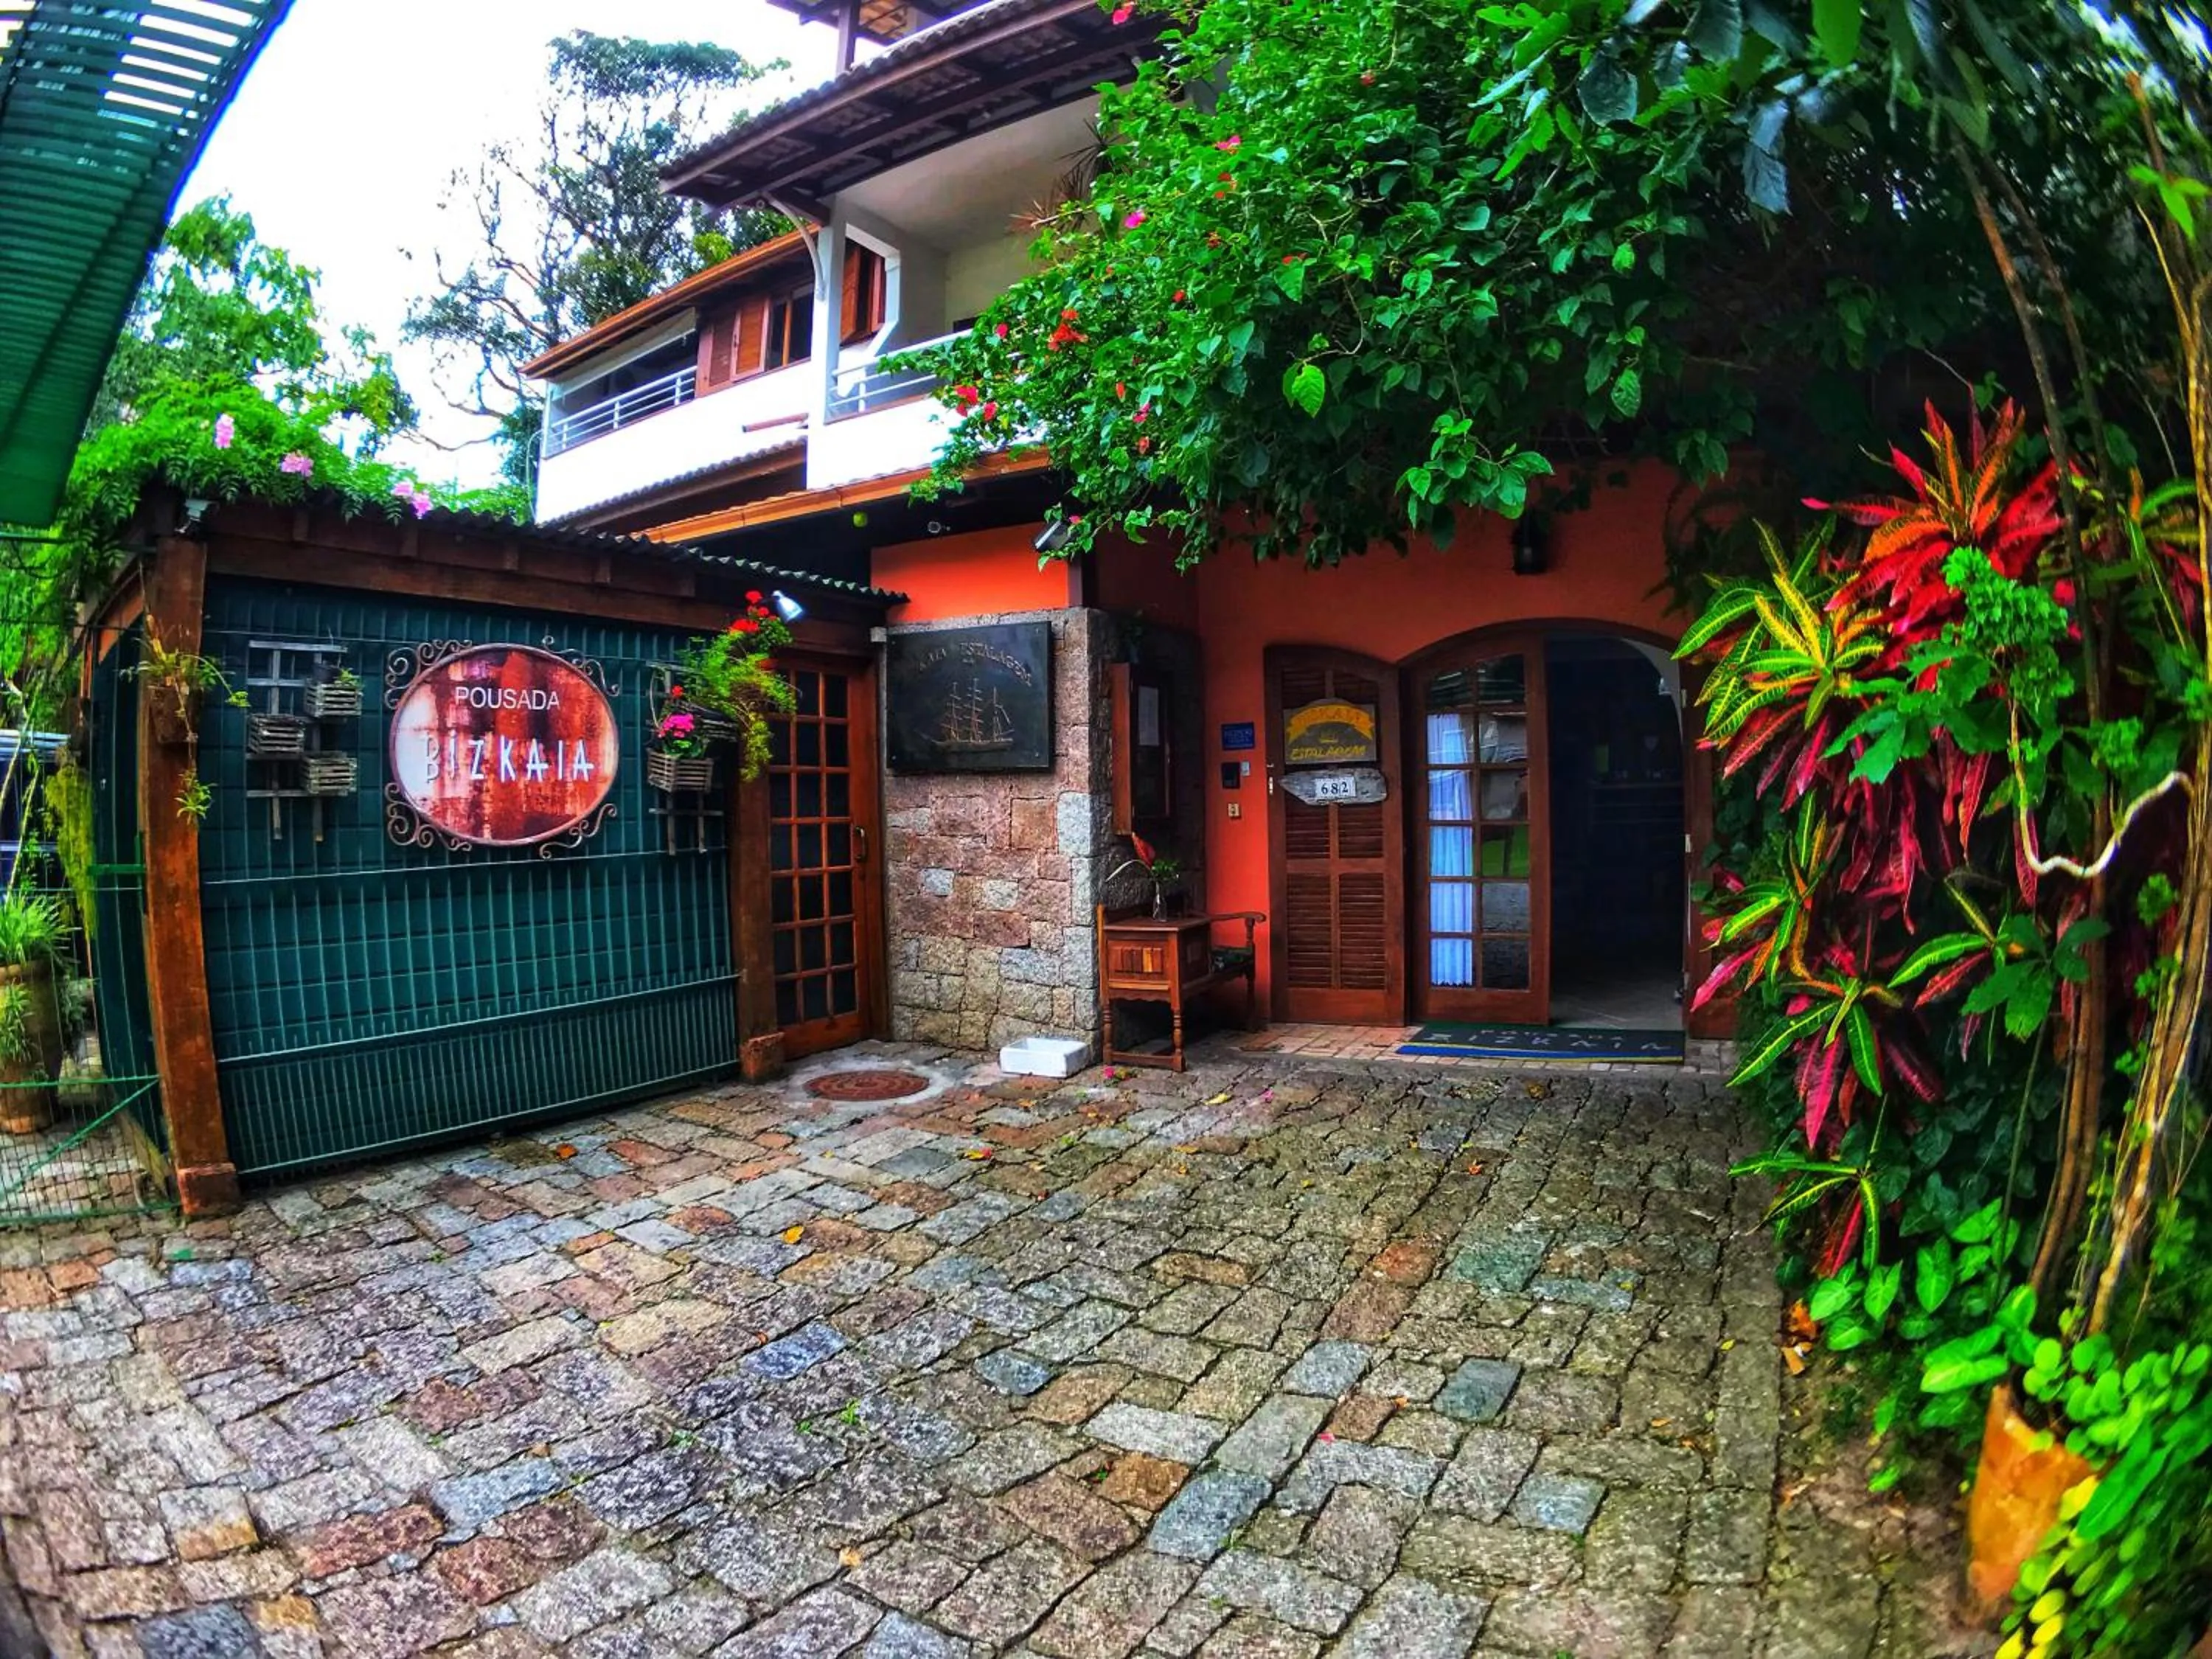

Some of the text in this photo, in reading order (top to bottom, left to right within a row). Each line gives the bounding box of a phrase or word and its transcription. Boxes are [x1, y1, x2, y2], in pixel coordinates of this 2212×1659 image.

[455, 686, 560, 710] POUSADA
[425, 729, 594, 783] BIZKAIA
[1321, 782, 1349, 795] 682
